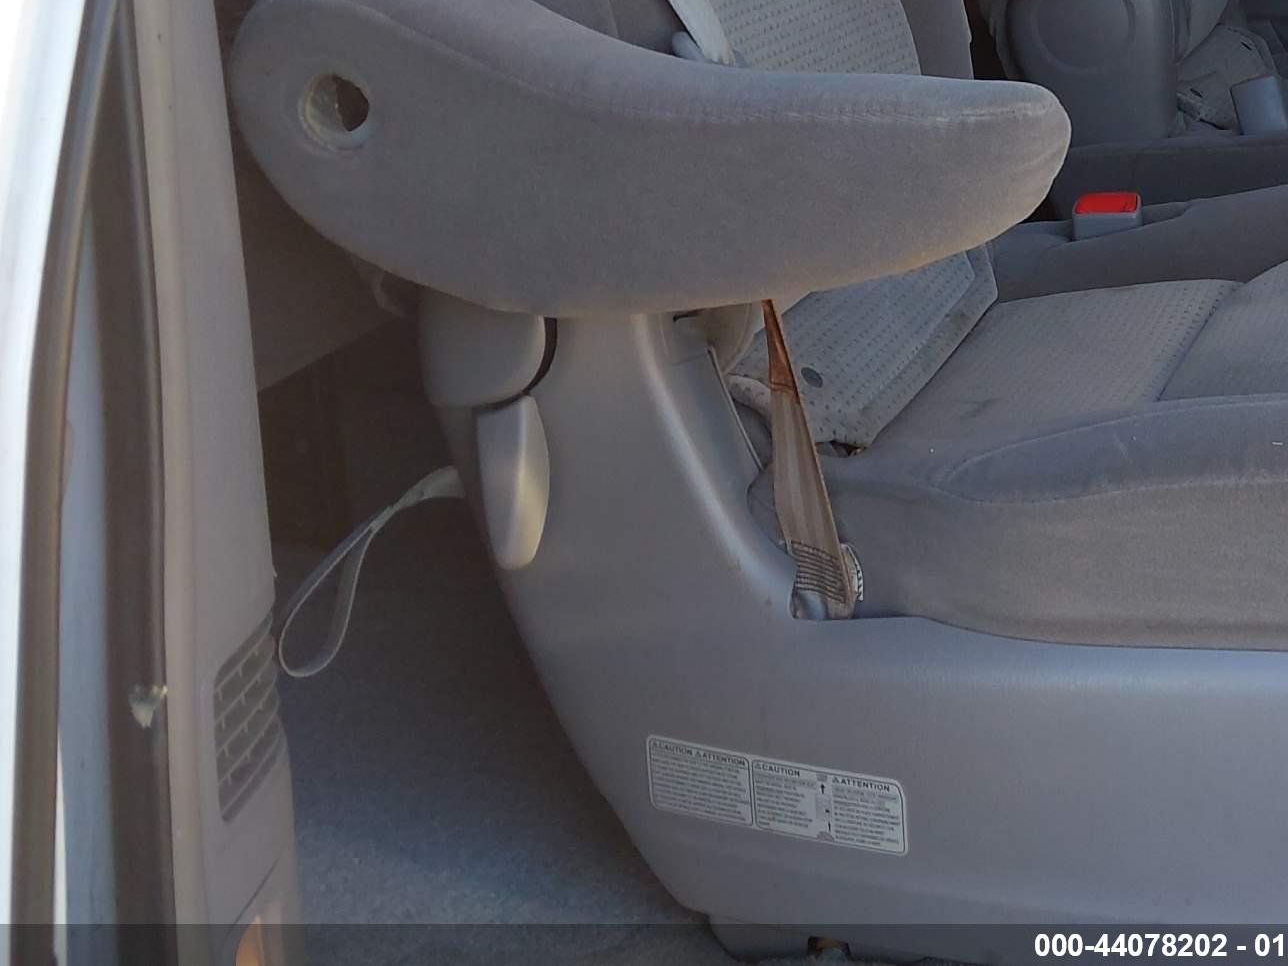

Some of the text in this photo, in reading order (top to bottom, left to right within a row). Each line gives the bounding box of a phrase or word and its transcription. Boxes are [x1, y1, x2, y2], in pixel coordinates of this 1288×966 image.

[659, 742, 745, 766] CAUTION ATTENTION
[762, 764, 800, 777] CAUTION
[841, 778, 890, 792] ATTENTION
